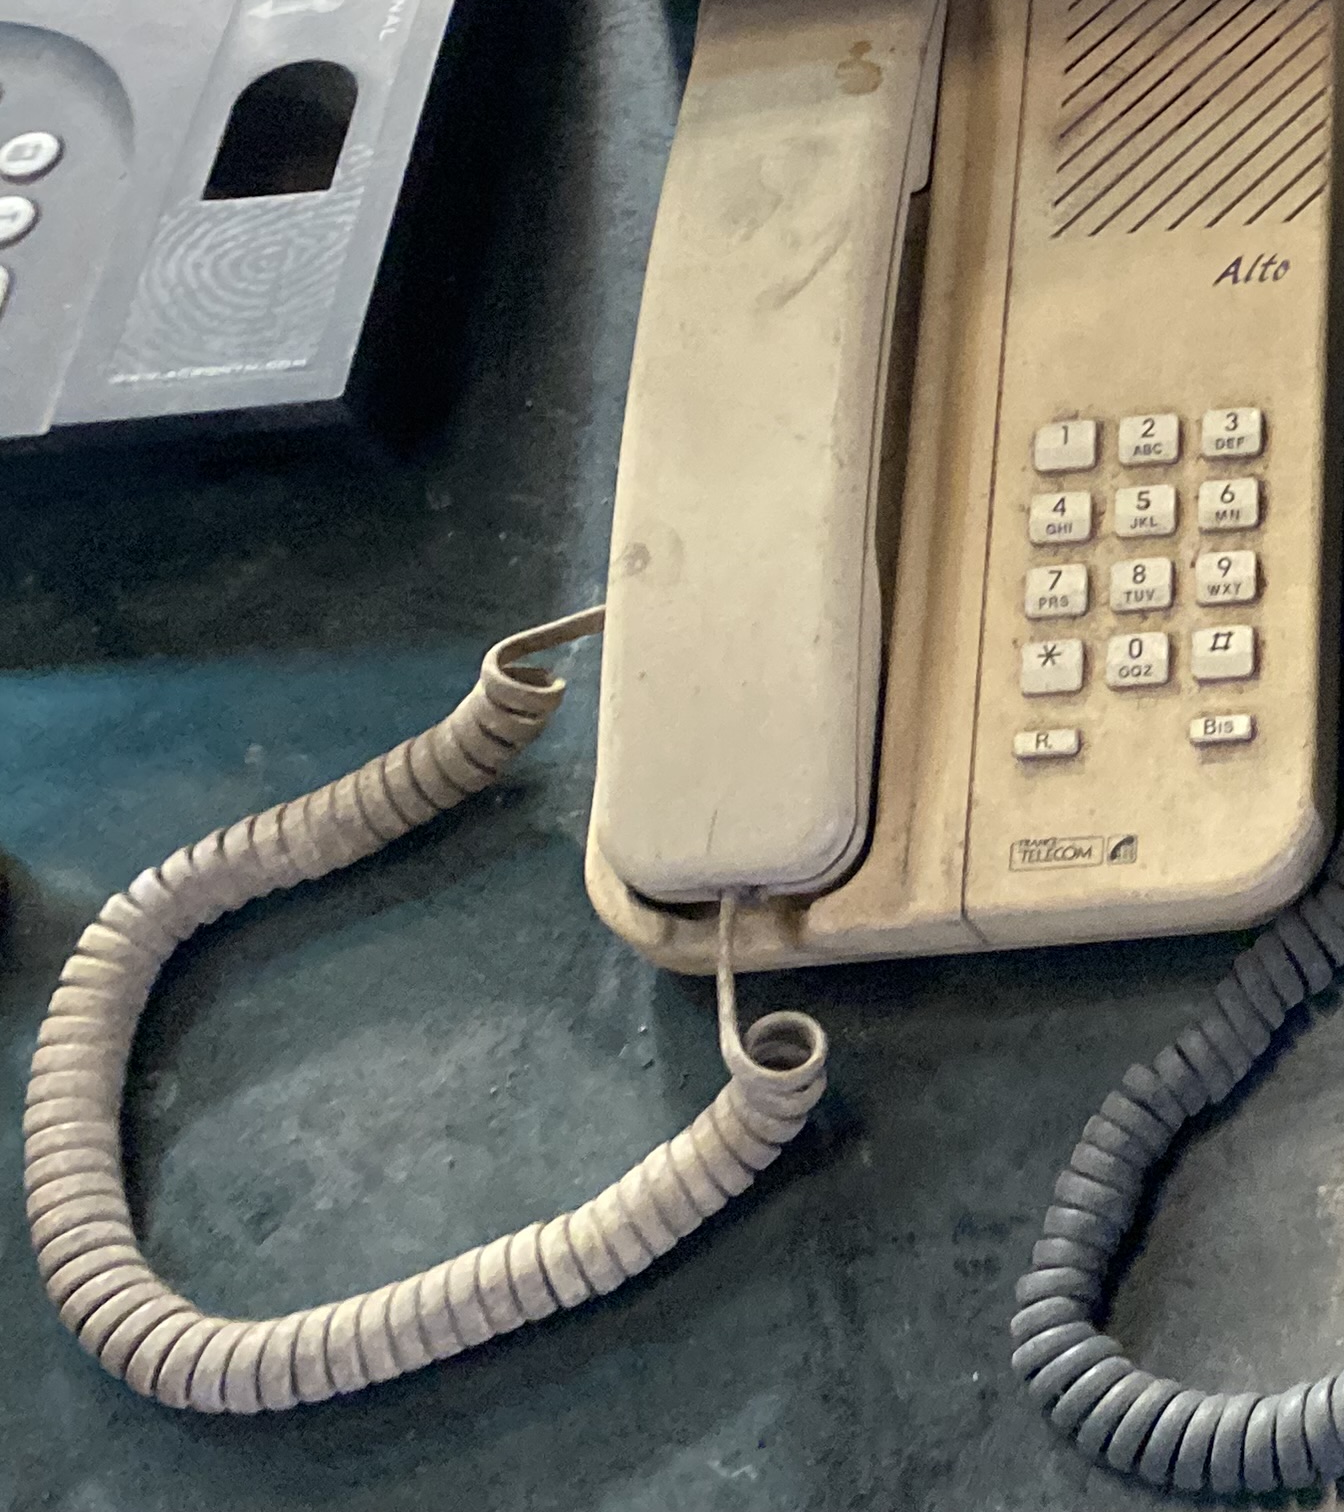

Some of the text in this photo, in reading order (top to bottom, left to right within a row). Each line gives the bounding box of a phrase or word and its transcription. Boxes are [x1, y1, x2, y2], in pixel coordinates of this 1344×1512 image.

[1212, 253, 1290, 287] Alto
[1141, 418, 1155, 438] 2
[1225, 413, 1238, 432] 3
[1061, 425, 1068, 445] 1
[1215, 437, 1245, 450] DEF
[1133, 443, 1162, 457] ABC
[1136, 491, 1151, 511] 5
[1220, 484, 1235, 503] 6
[1053, 497, 1066, 516] 4
[1215, 510, 1239, 521] MN
[1046, 522, 1072, 535] GHI
[1130, 516, 1158, 529] JKL
[1133, 564, 1146, 584] 8
[1218, 557, 1231, 578] 9
[1049, 570, 1062, 591] 7
[1207, 583, 1241, 595] WXY
[1039, 596, 1069, 610] PRS
[1124, 590, 1155, 603] TUV
[1128, 639, 1142, 659] 0
[1021, 843, 1092, 863] TELECOM
